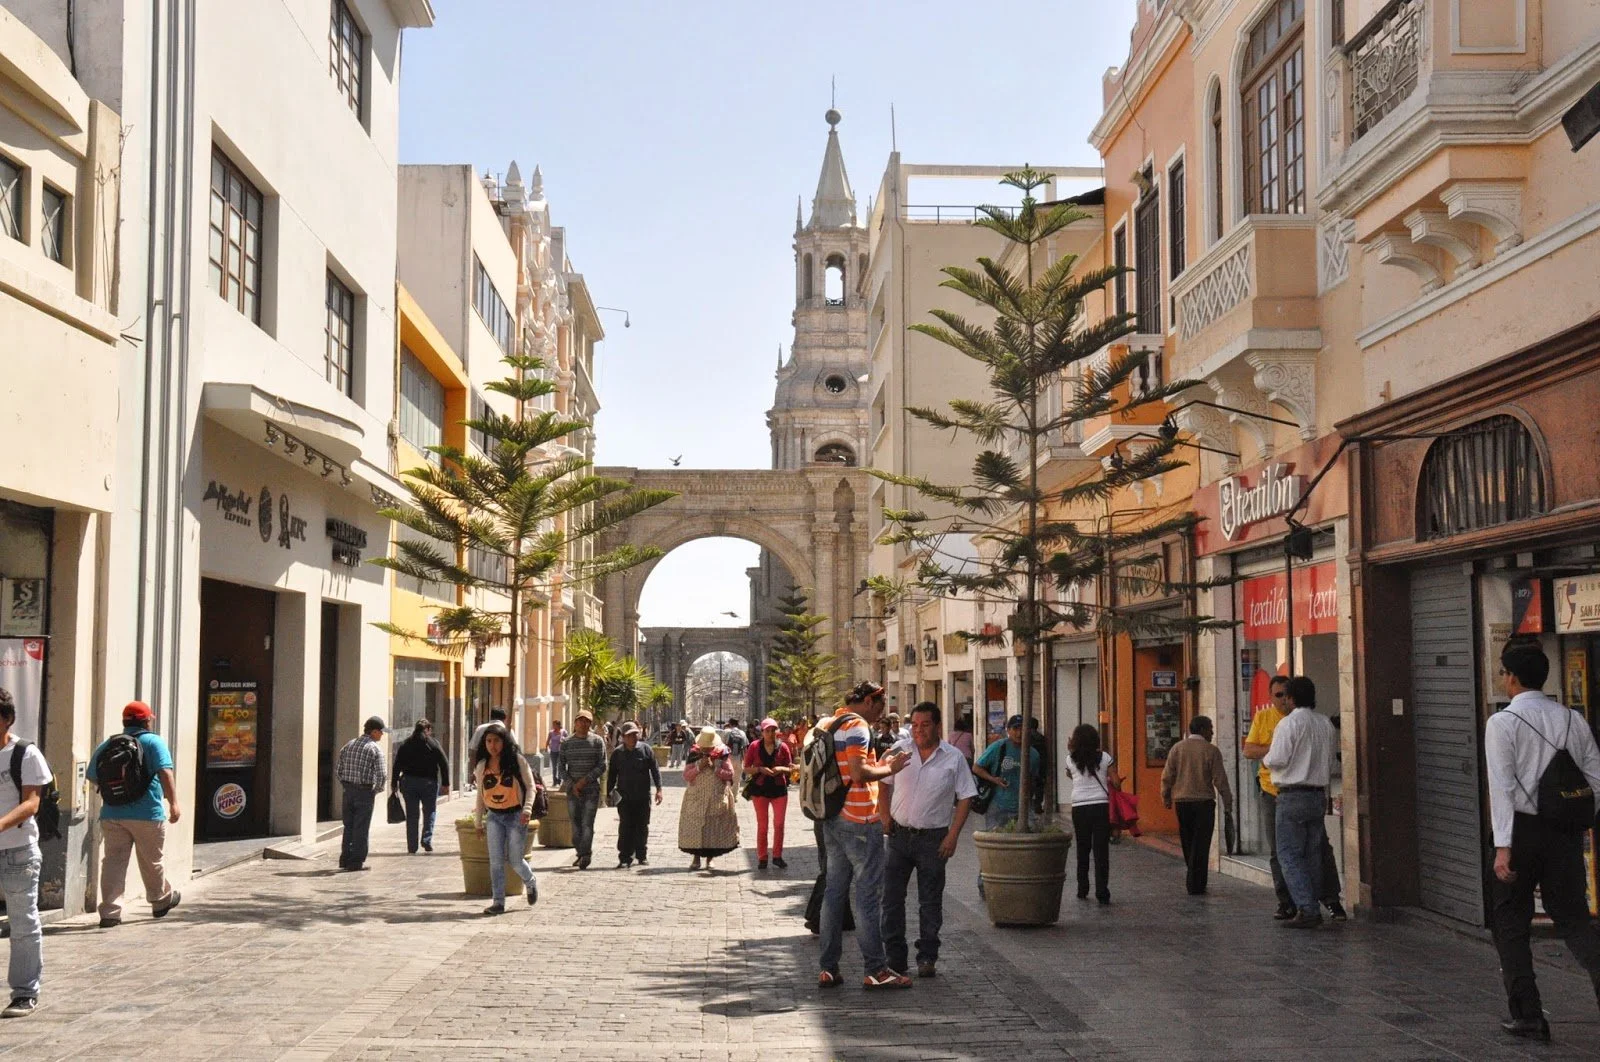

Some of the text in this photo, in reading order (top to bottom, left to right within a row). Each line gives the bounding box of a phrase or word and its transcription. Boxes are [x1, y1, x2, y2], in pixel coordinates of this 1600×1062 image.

[1236, 463, 1294, 526] textilón
[1580, 605, 1593, 617] SAN
[217, 789, 242, 803] BURGER
[218, 795, 243, 811] KING
